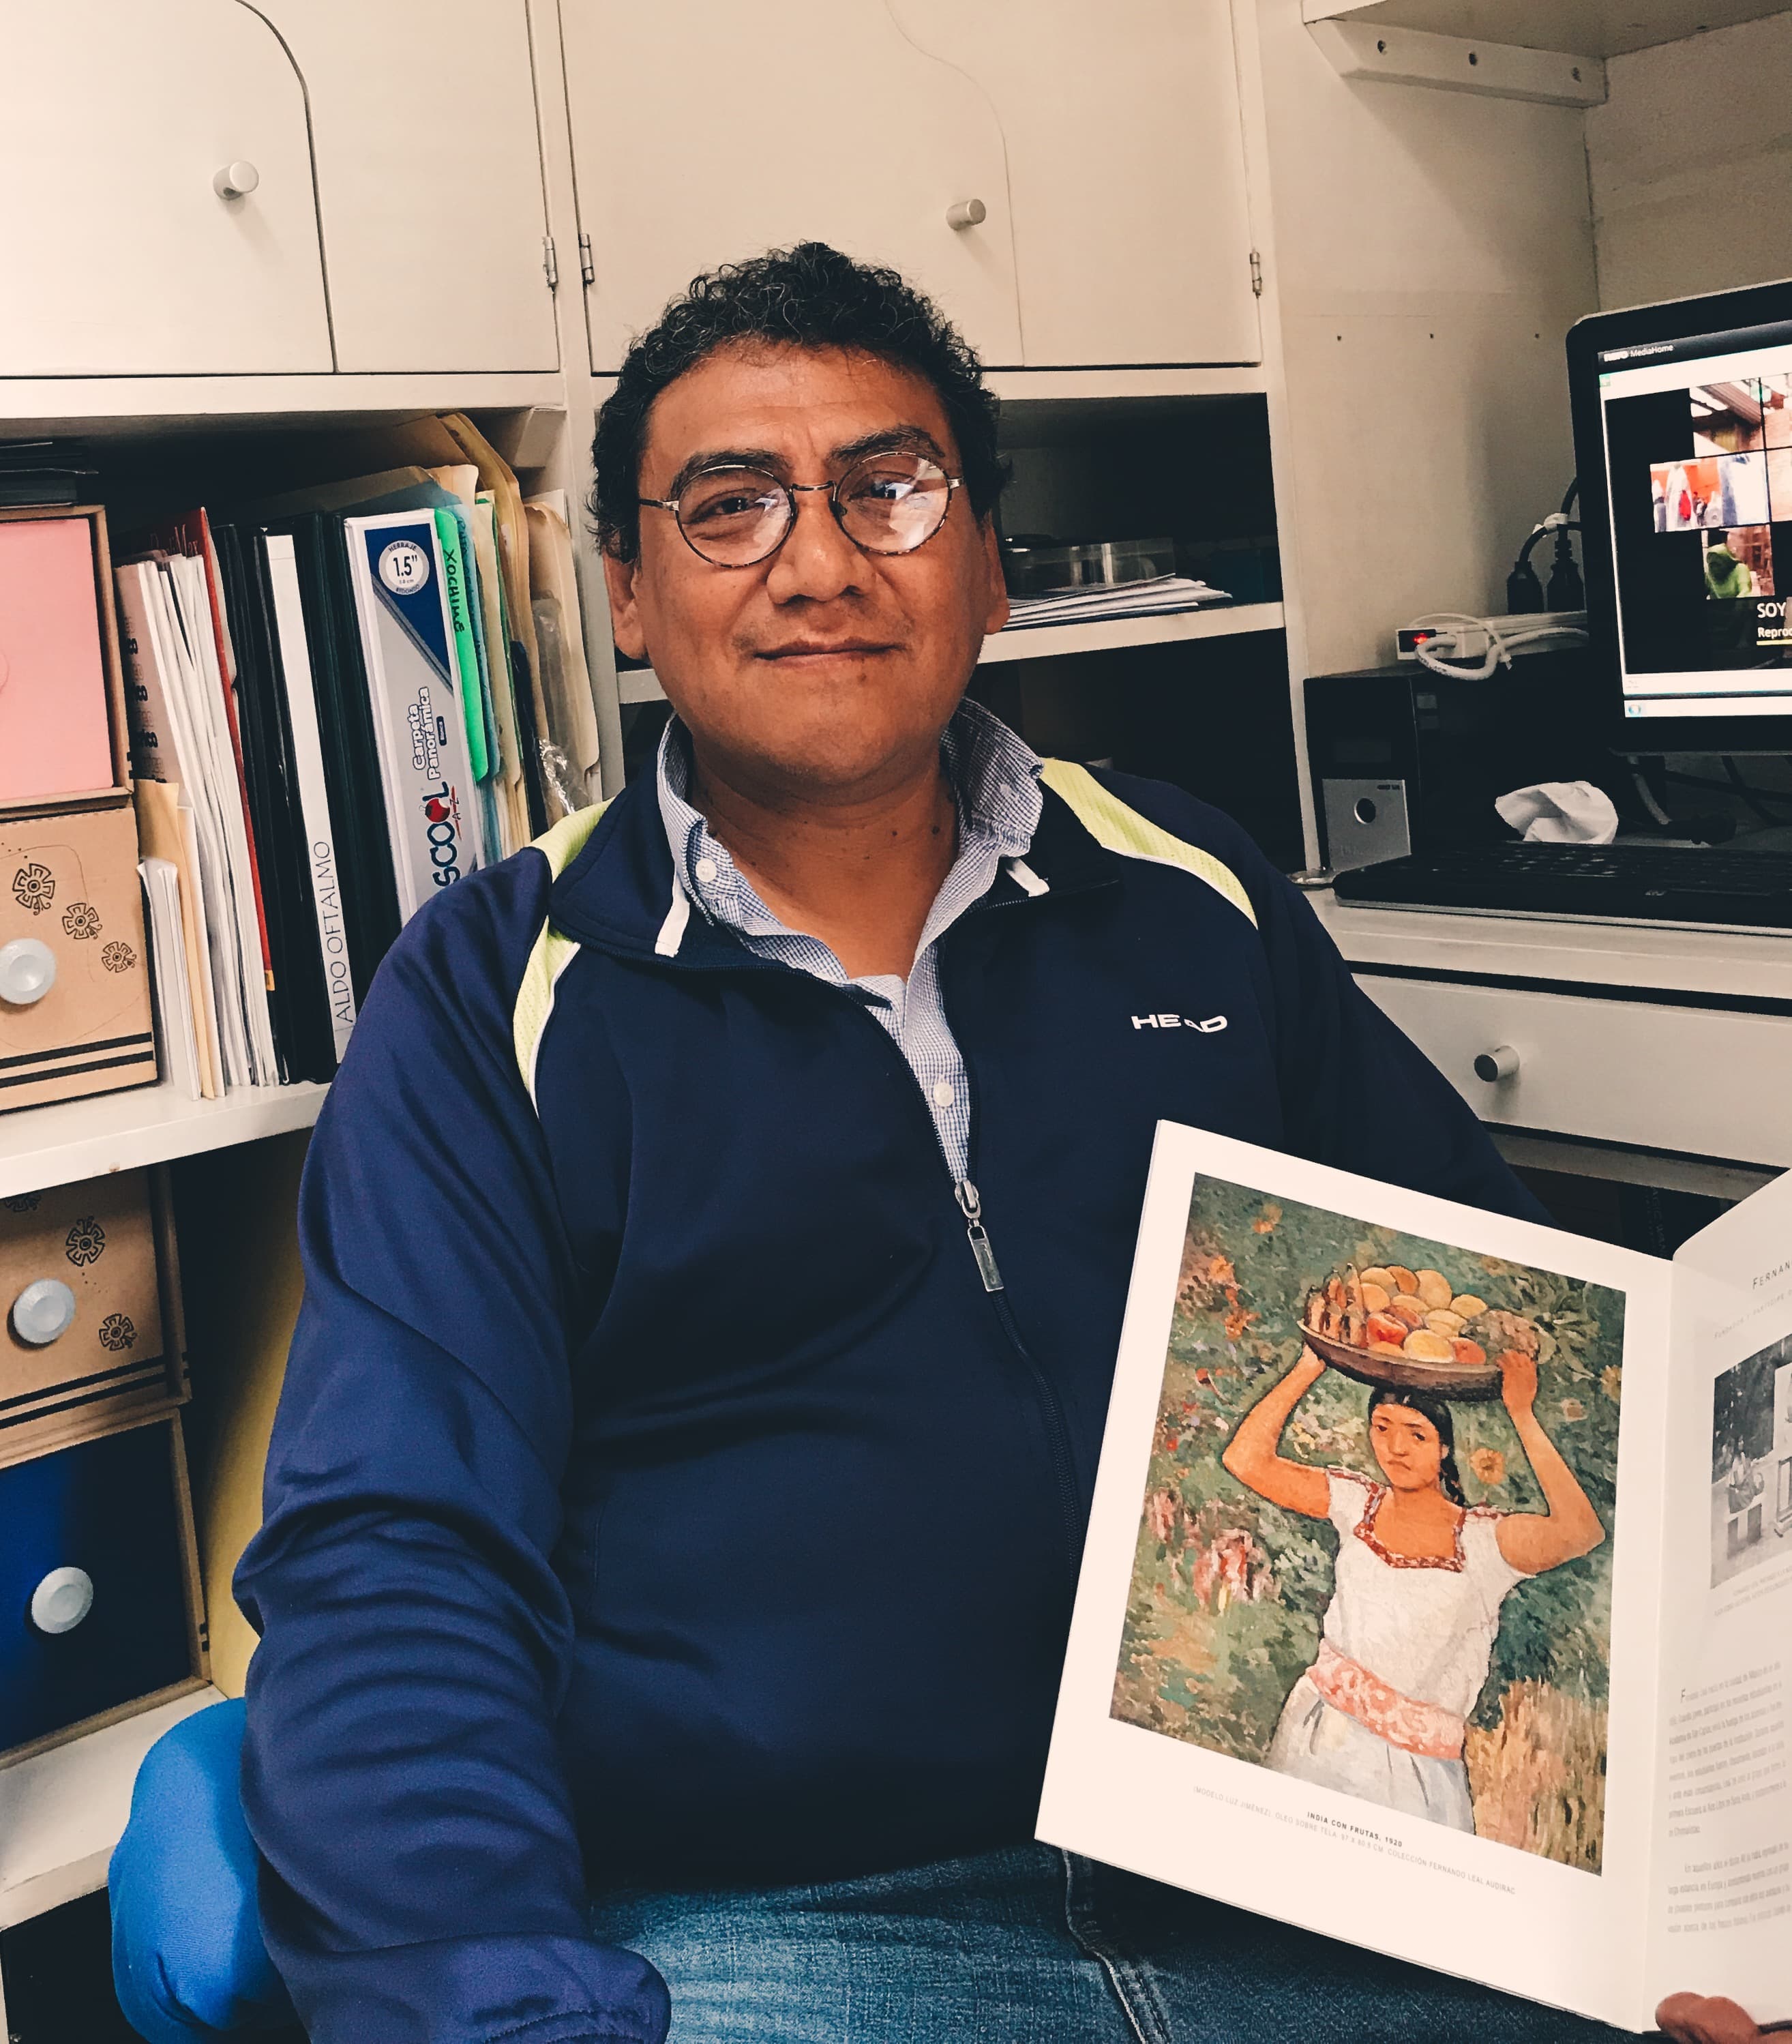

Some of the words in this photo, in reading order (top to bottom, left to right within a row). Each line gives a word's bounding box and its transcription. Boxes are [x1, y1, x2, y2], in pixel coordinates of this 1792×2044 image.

[1630, 344, 1674, 357] MediaHome
[388, 542, 417, 552] HERRAJE
[393, 554, 418, 577] 1.5"
[444, 548, 465, 633] XOCHIME
[1757, 602, 1787, 619] SOY
[408, 704, 426, 770] Carpeta
[419, 686, 441, 780] Panorámica
[314, 841, 343, 953] OFTALMO
[330, 961, 353, 1023] ALDO
[1752, 1260, 1792, 1290] FERNAN
[1296, 1818, 1318, 1833] SOBRE
[1429, 1861, 1467, 1879] FERNANDO
[1467, 1874, 1484, 1885] LEAL
[1307, 1811, 1328, 1824] INDIA
[1331, 1820, 1347, 1830] CON
[1350, 1825, 1382, 1841] FRUTAS,
[1385, 1837, 1403, 1848] 1920
